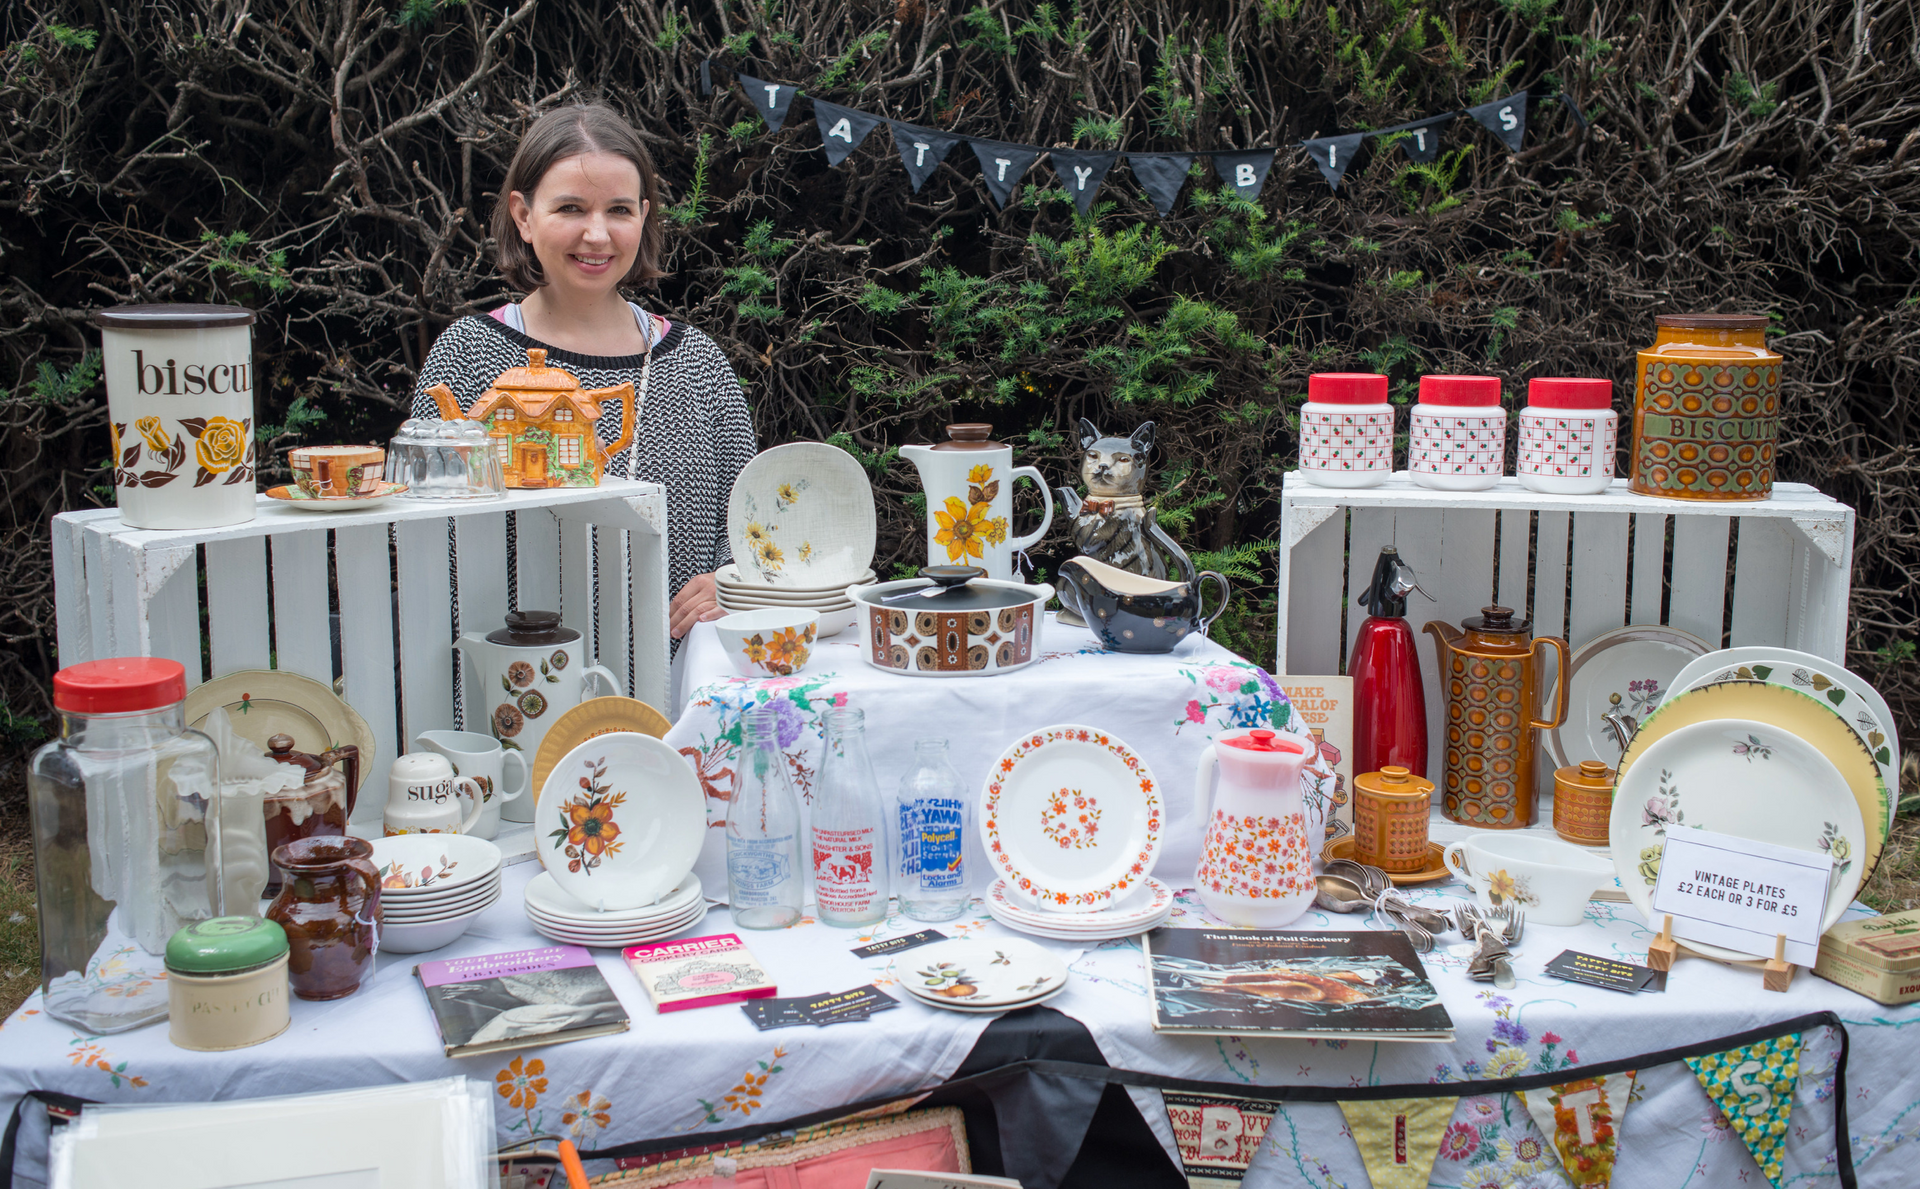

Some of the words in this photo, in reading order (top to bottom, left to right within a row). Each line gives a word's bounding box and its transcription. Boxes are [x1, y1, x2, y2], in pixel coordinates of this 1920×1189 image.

[1290, 699, 1319, 711] EAL
[1320, 699, 1339, 711] OF
[1300, 712, 1329, 724] ESE
[408, 778, 455, 805] suga
[922, 874, 946, 882] Locks
[947, 870, 962, 880] and
[928, 879, 958, 887] Alarms
[1694, 869, 1740, 890] VINTAGE
[1742, 880, 1786, 899] PLATES
[1677, 881, 1694, 895] £2
[1696, 885, 1725, 901] EACH
[1728, 892, 1743, 905] OR
[1746, 896, 1753, 907] 3
[1756, 899, 1778, 913] FOR
[1781, 904, 1798, 917] £5
[634, 937, 739, 958] CARRIER
[641, 952, 697, 963] COOKERY
[699, 946, 740, 955] CARDS
[444, 956, 487, 967] YOUR
[494, 951, 537, 960] BOOK
[448, 954, 566, 974] Embroidery
